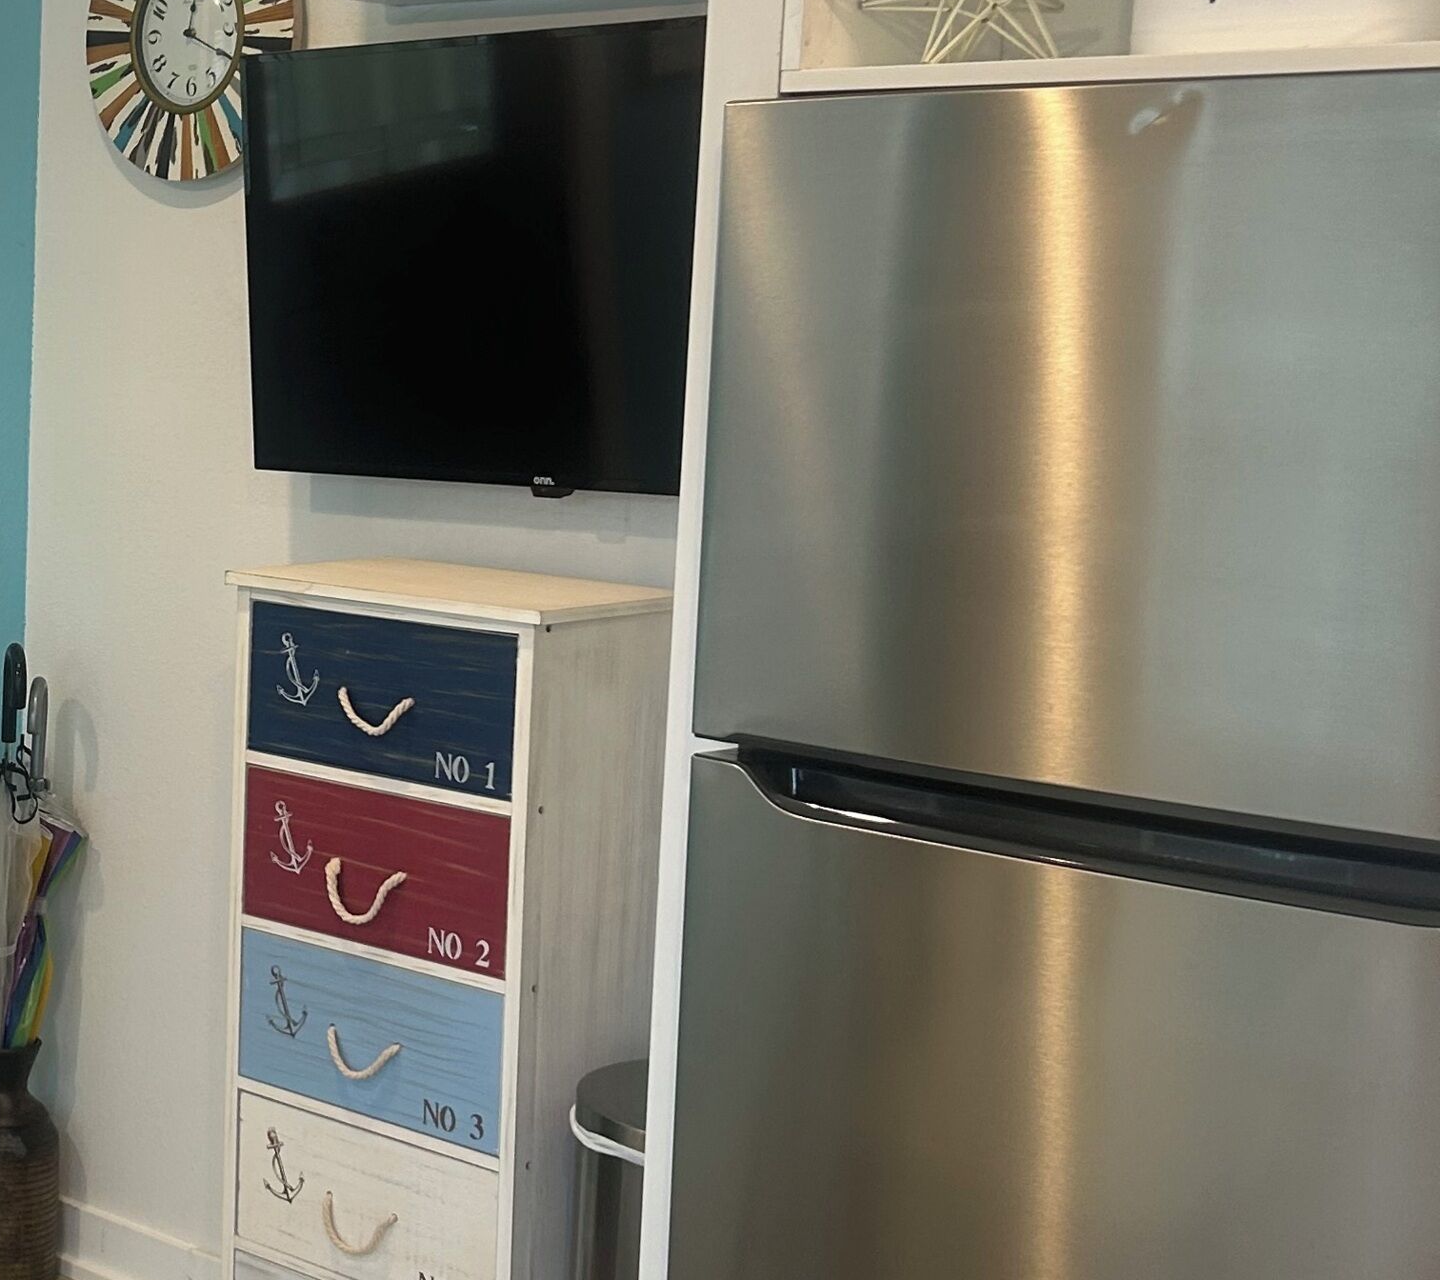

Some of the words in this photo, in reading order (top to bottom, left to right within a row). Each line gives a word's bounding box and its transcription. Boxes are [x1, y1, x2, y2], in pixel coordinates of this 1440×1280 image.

[153, 0, 168, 21] 10
[148, 29, 162, 45] 9
[152, 54, 167, 73] 8
[167, 71, 180, 89] 7
[186, 76, 197, 97] 6
[434, 751, 470, 783] NO
[485, 762, 496, 790] 1
[427, 926, 462, 960] NO
[475, 940, 491, 968] 2
[422, 1098, 456, 1133] NO
[470, 1113, 485, 1141] 3
